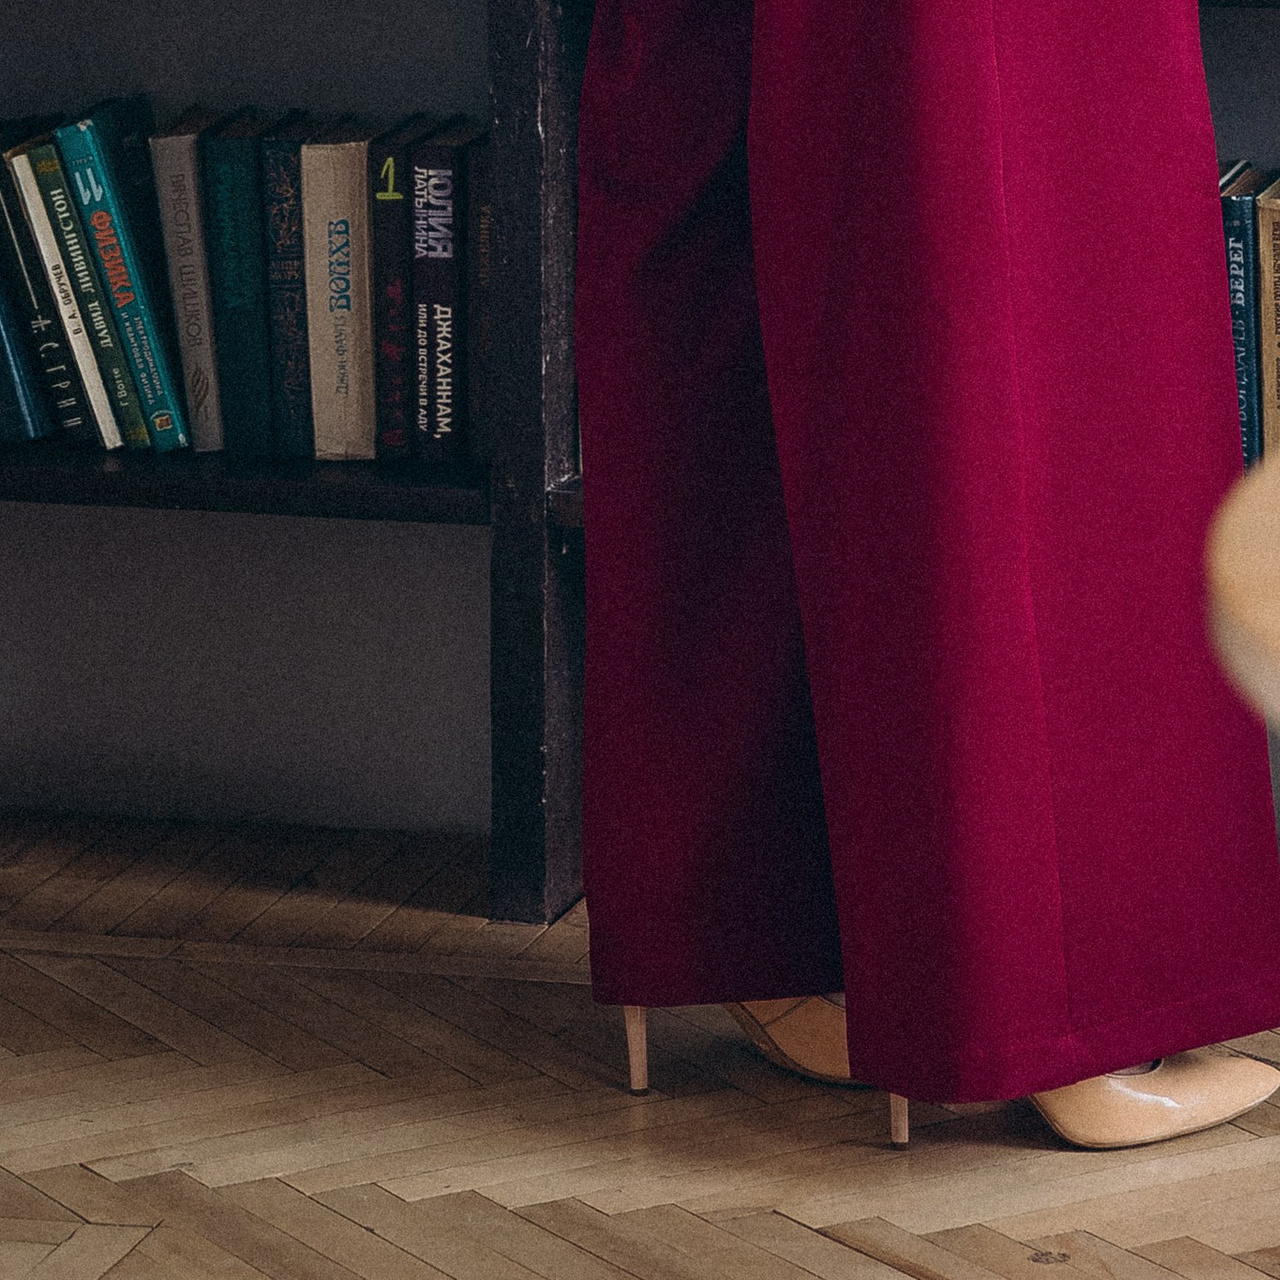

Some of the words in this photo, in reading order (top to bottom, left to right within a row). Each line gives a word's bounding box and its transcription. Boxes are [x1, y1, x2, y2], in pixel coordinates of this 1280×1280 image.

[49, 187, 96, 293] ЛИВИНГСТОН
[414, 166, 427, 258] ЛАТЫНИНА
[427, 168, 455, 258] ЮЛИЯ
[89, 209, 138, 307] ФИЗИКА
[1228, 237, 1246, 307] БЕРЕГ
[80, 300, 114, 348] ДАВИД
